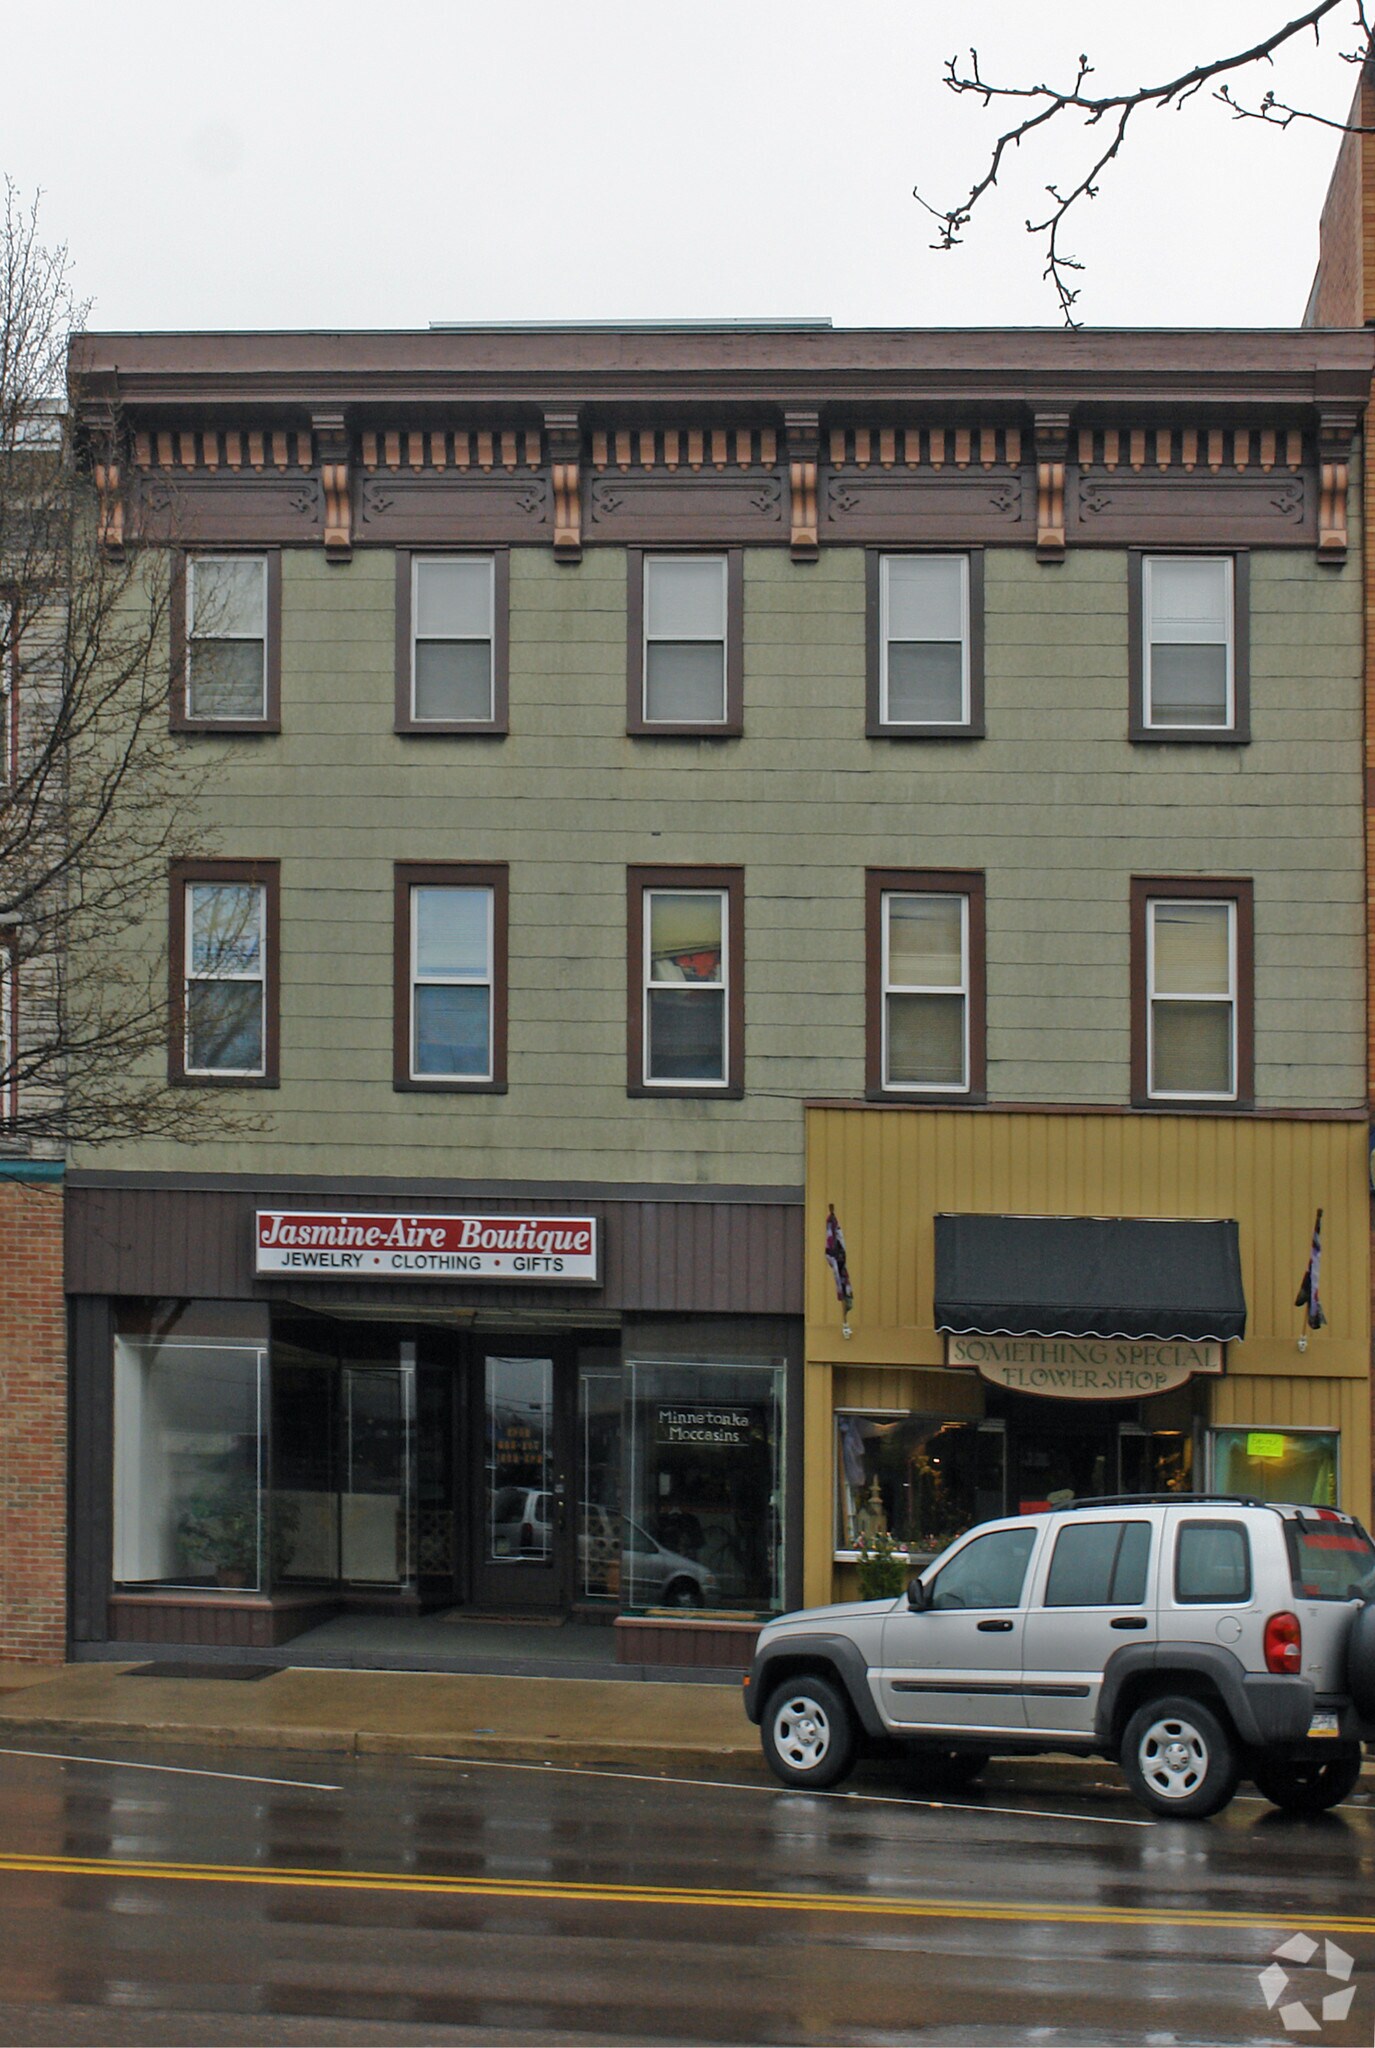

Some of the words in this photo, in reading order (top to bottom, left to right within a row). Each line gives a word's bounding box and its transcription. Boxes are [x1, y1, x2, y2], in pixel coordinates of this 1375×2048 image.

[261, 1216, 447, 1248] Jasmine-Aire
[457, 1220, 590, 1254] Boutique
[281, 1252, 364, 1268] JEWELRY
[391, 1254, 481, 1270] CLOTHING
[513, 1256, 564, 1272] GIFTS
[954, 1341, 1108, 1365] SOMETHING
[1115, 1345, 1218, 1368] SPECIAL
[1002, 1367, 1099, 1388] FLOWER
[1102, 1370, 1167, 1389] SHOP
[658, 1410, 749, 1427] Minnetonka
[668, 1426, 740, 1442] Moccasins
